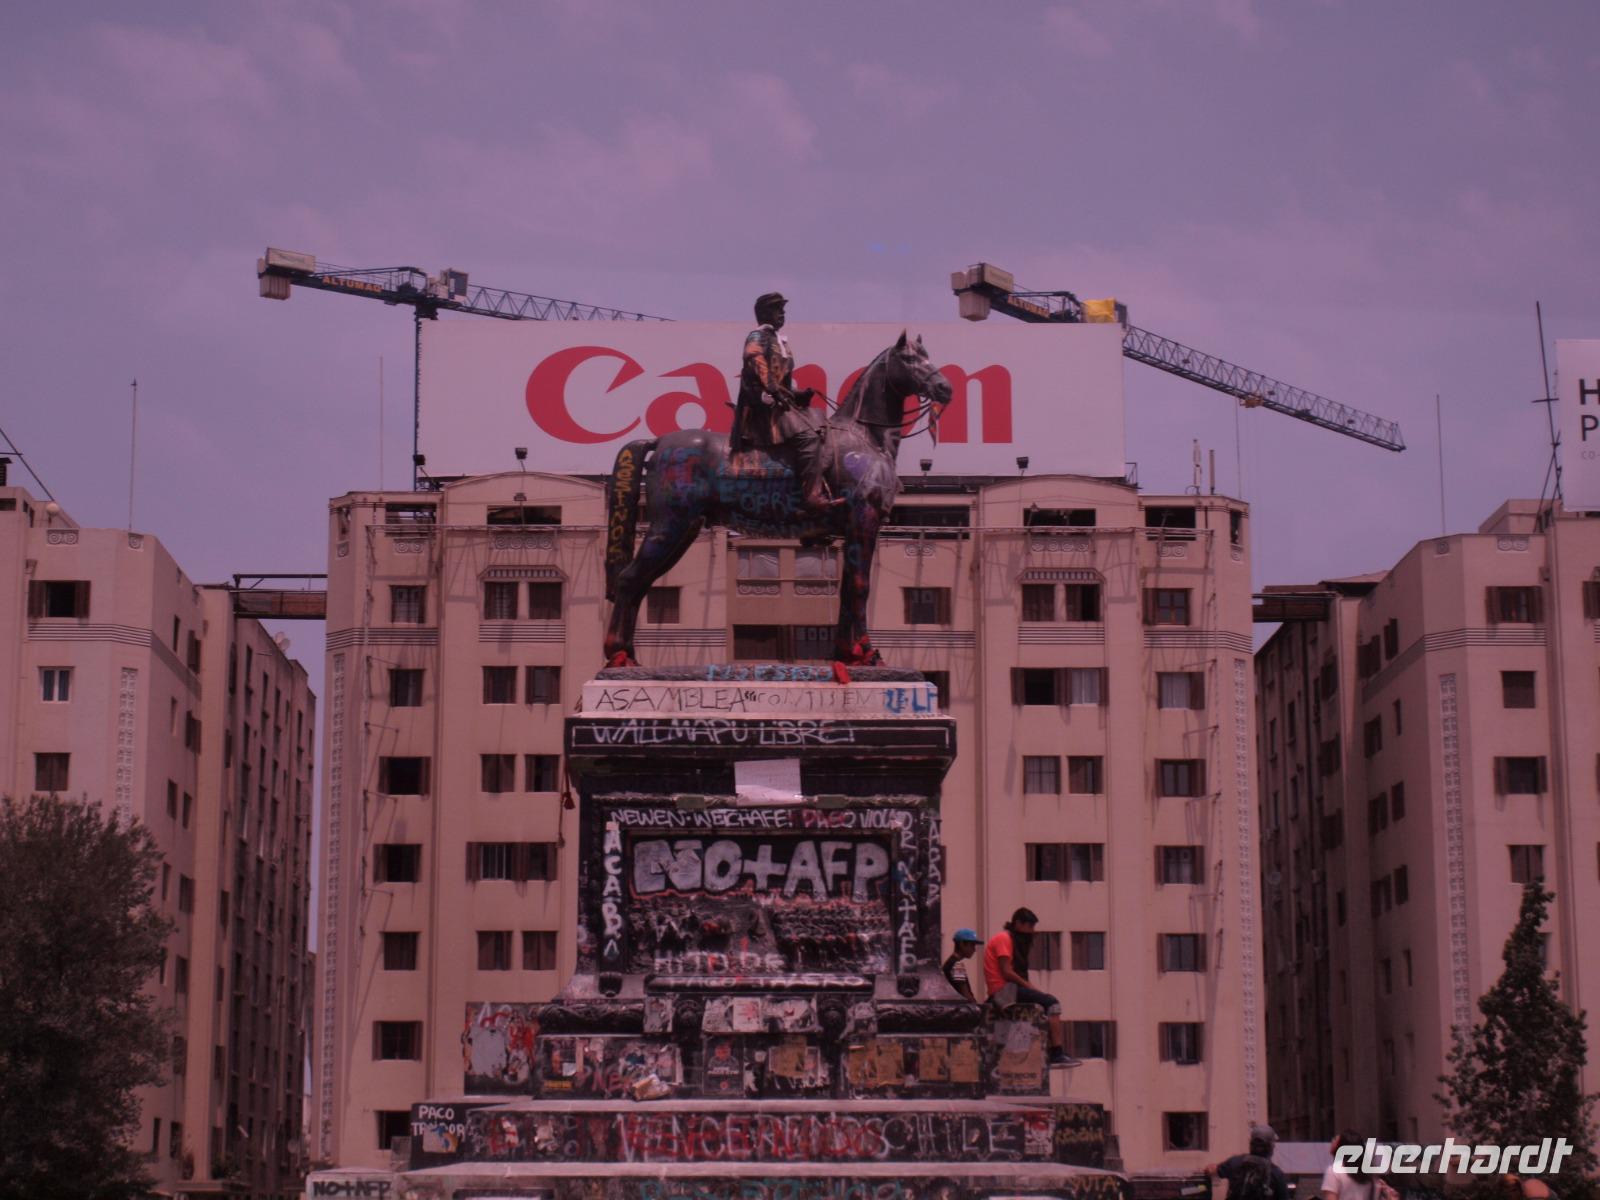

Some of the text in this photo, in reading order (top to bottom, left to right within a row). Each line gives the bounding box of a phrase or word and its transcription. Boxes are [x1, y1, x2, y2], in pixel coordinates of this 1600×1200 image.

[418, 1104, 455, 1120] PACO
[882, 1112, 1018, 1154] CHILE
[312, 1180, 392, 1198] NO+AFP
